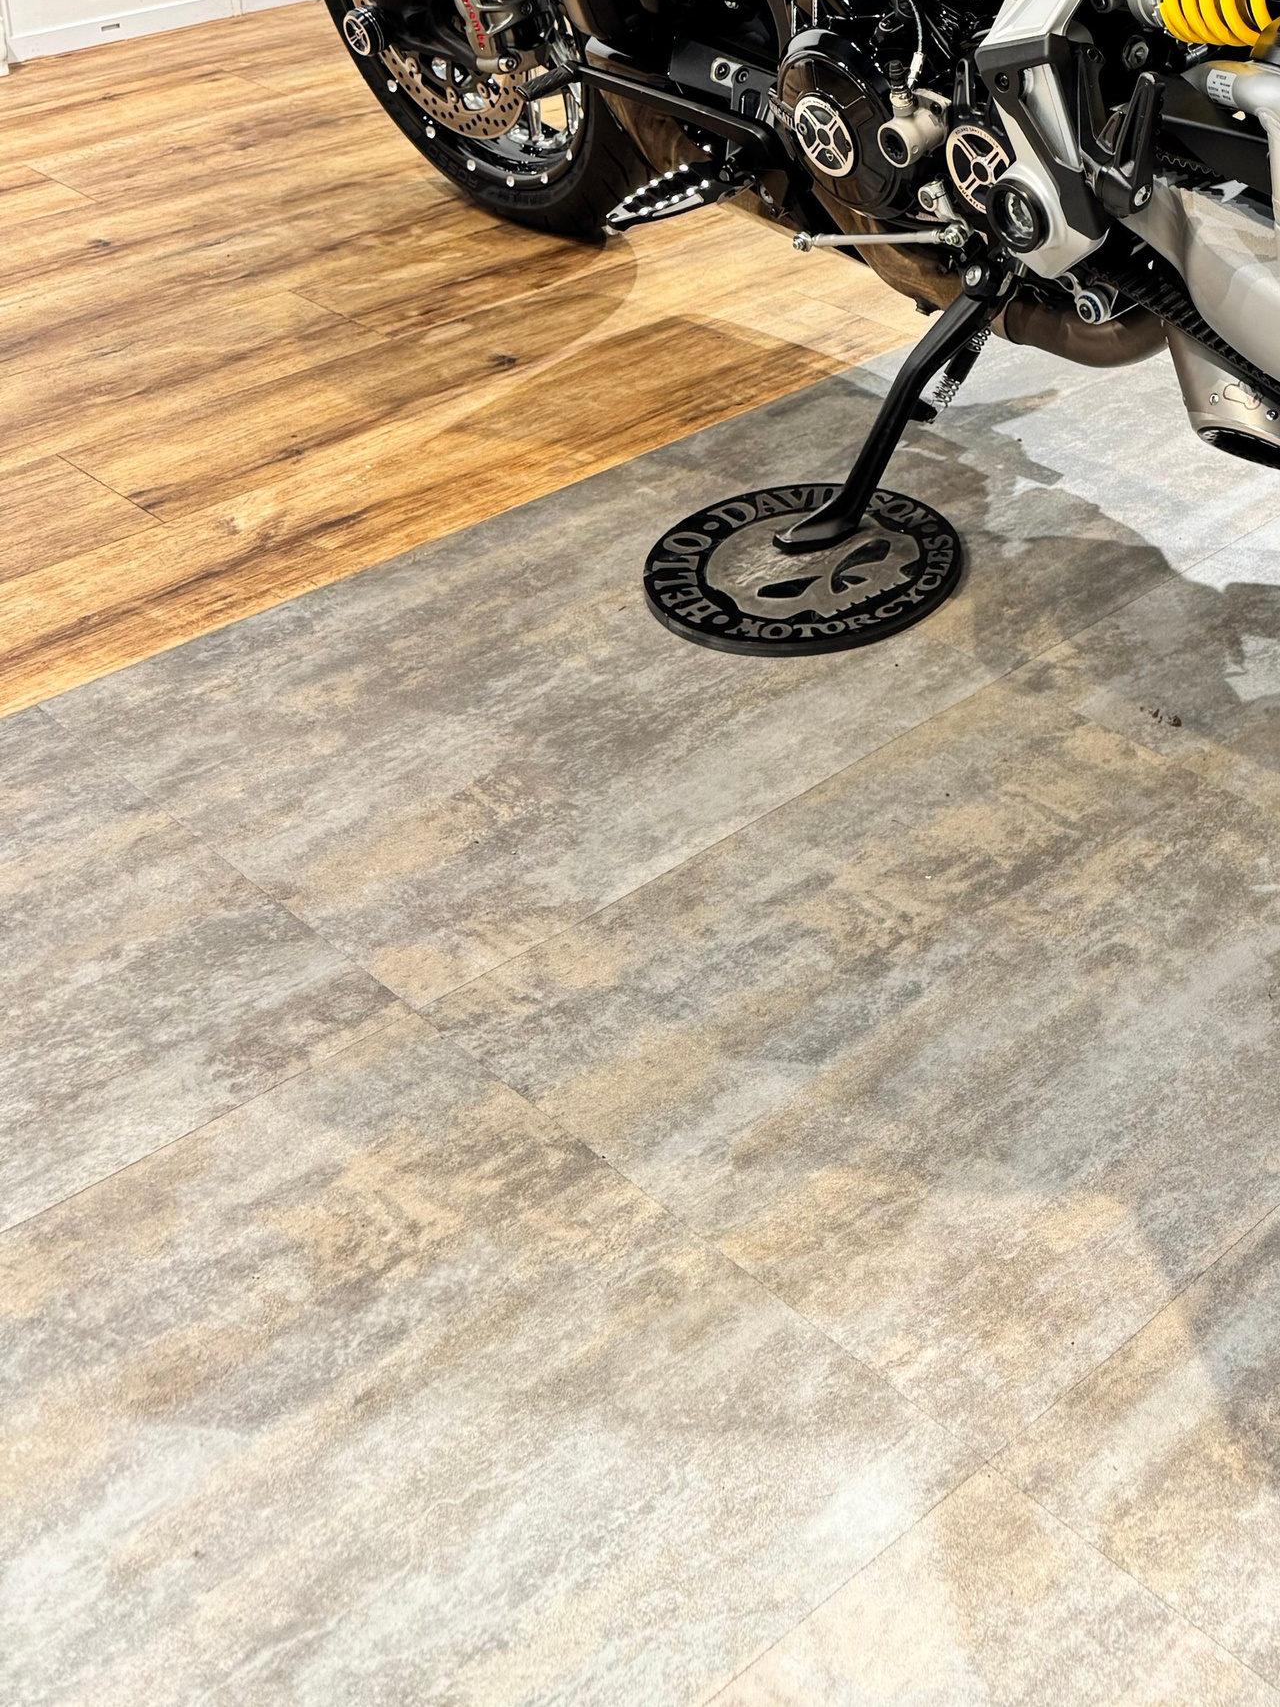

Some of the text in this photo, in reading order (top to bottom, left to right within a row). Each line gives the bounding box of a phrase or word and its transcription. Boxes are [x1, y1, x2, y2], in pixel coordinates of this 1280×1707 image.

[958, 185, 979, 208] DUCATI
[651, 531, 722, 625] HELLO
[724, 534, 954, 639] MOTORCYCLES
